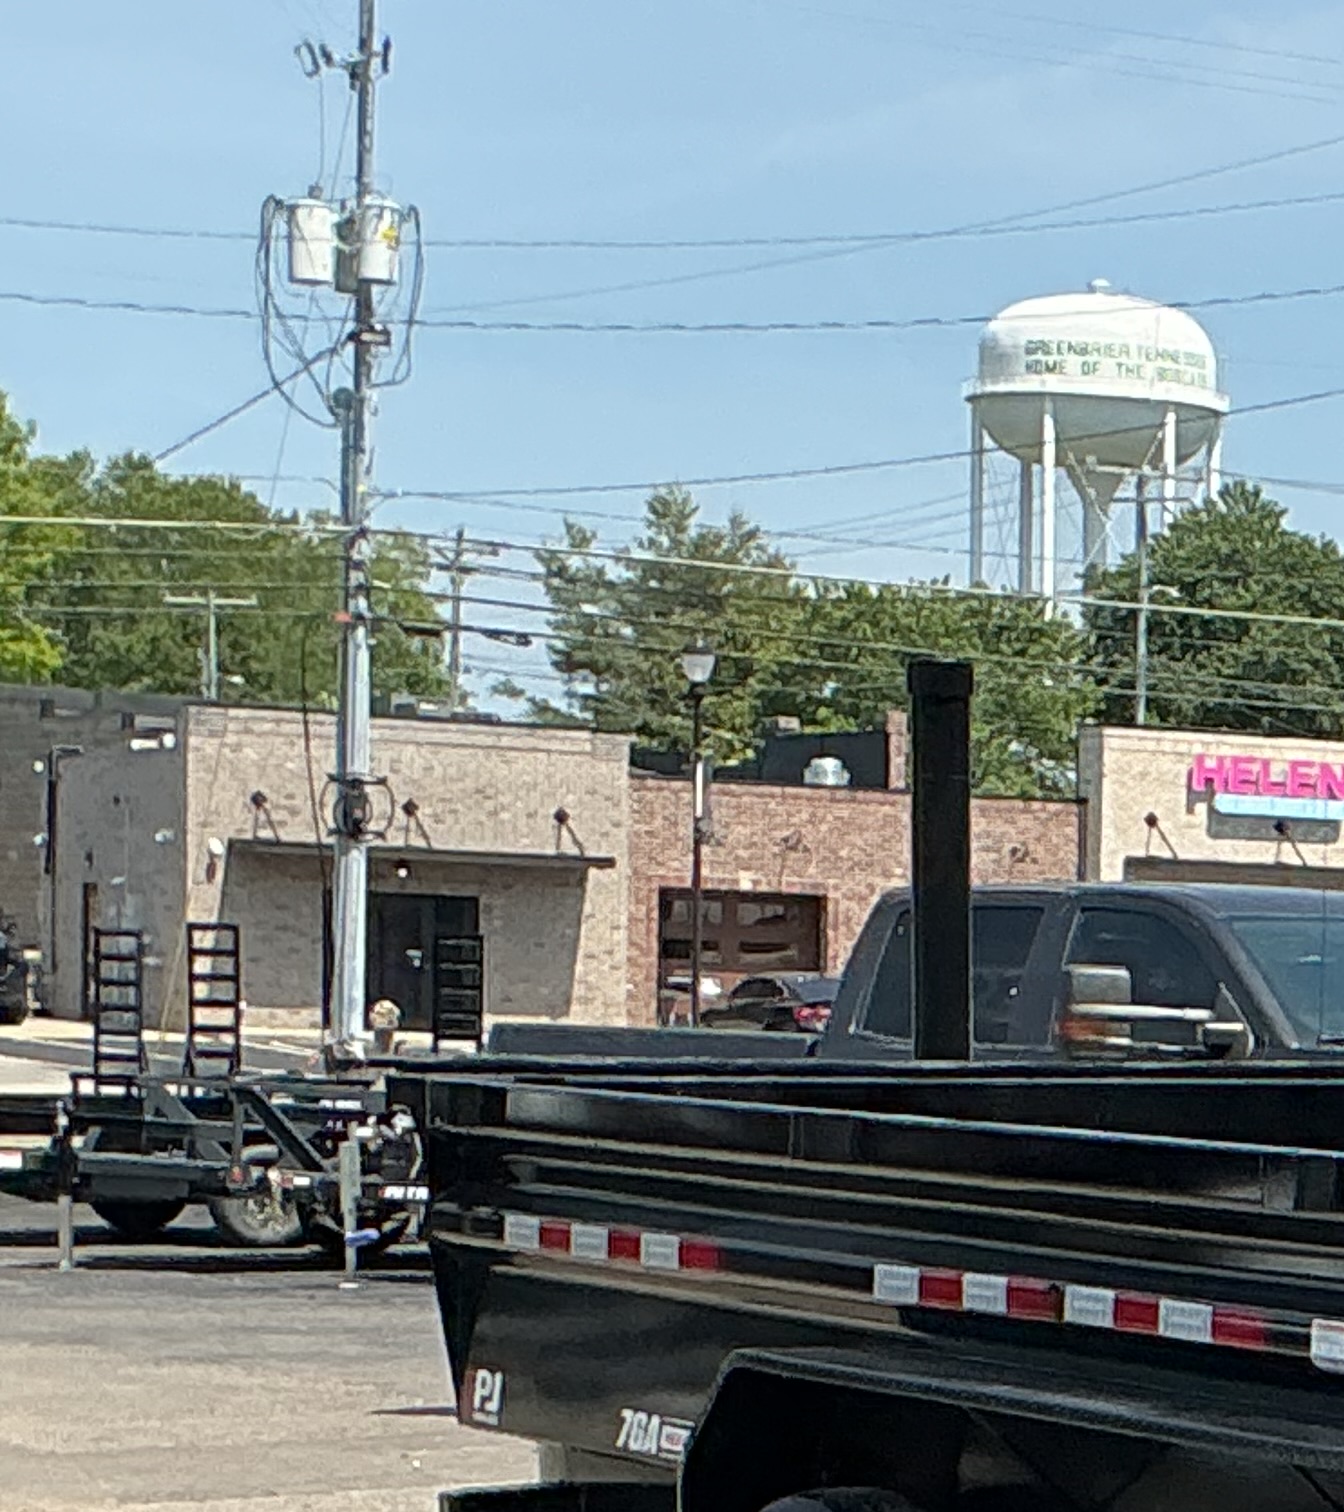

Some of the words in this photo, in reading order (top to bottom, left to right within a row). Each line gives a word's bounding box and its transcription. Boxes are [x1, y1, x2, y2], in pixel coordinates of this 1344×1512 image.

[1024, 359, 1067, 375] HOME
[1080, 360, 1100, 376] OF
[1116, 362, 1145, 380] THE
[473, 1368, 504, 1413] PJ
